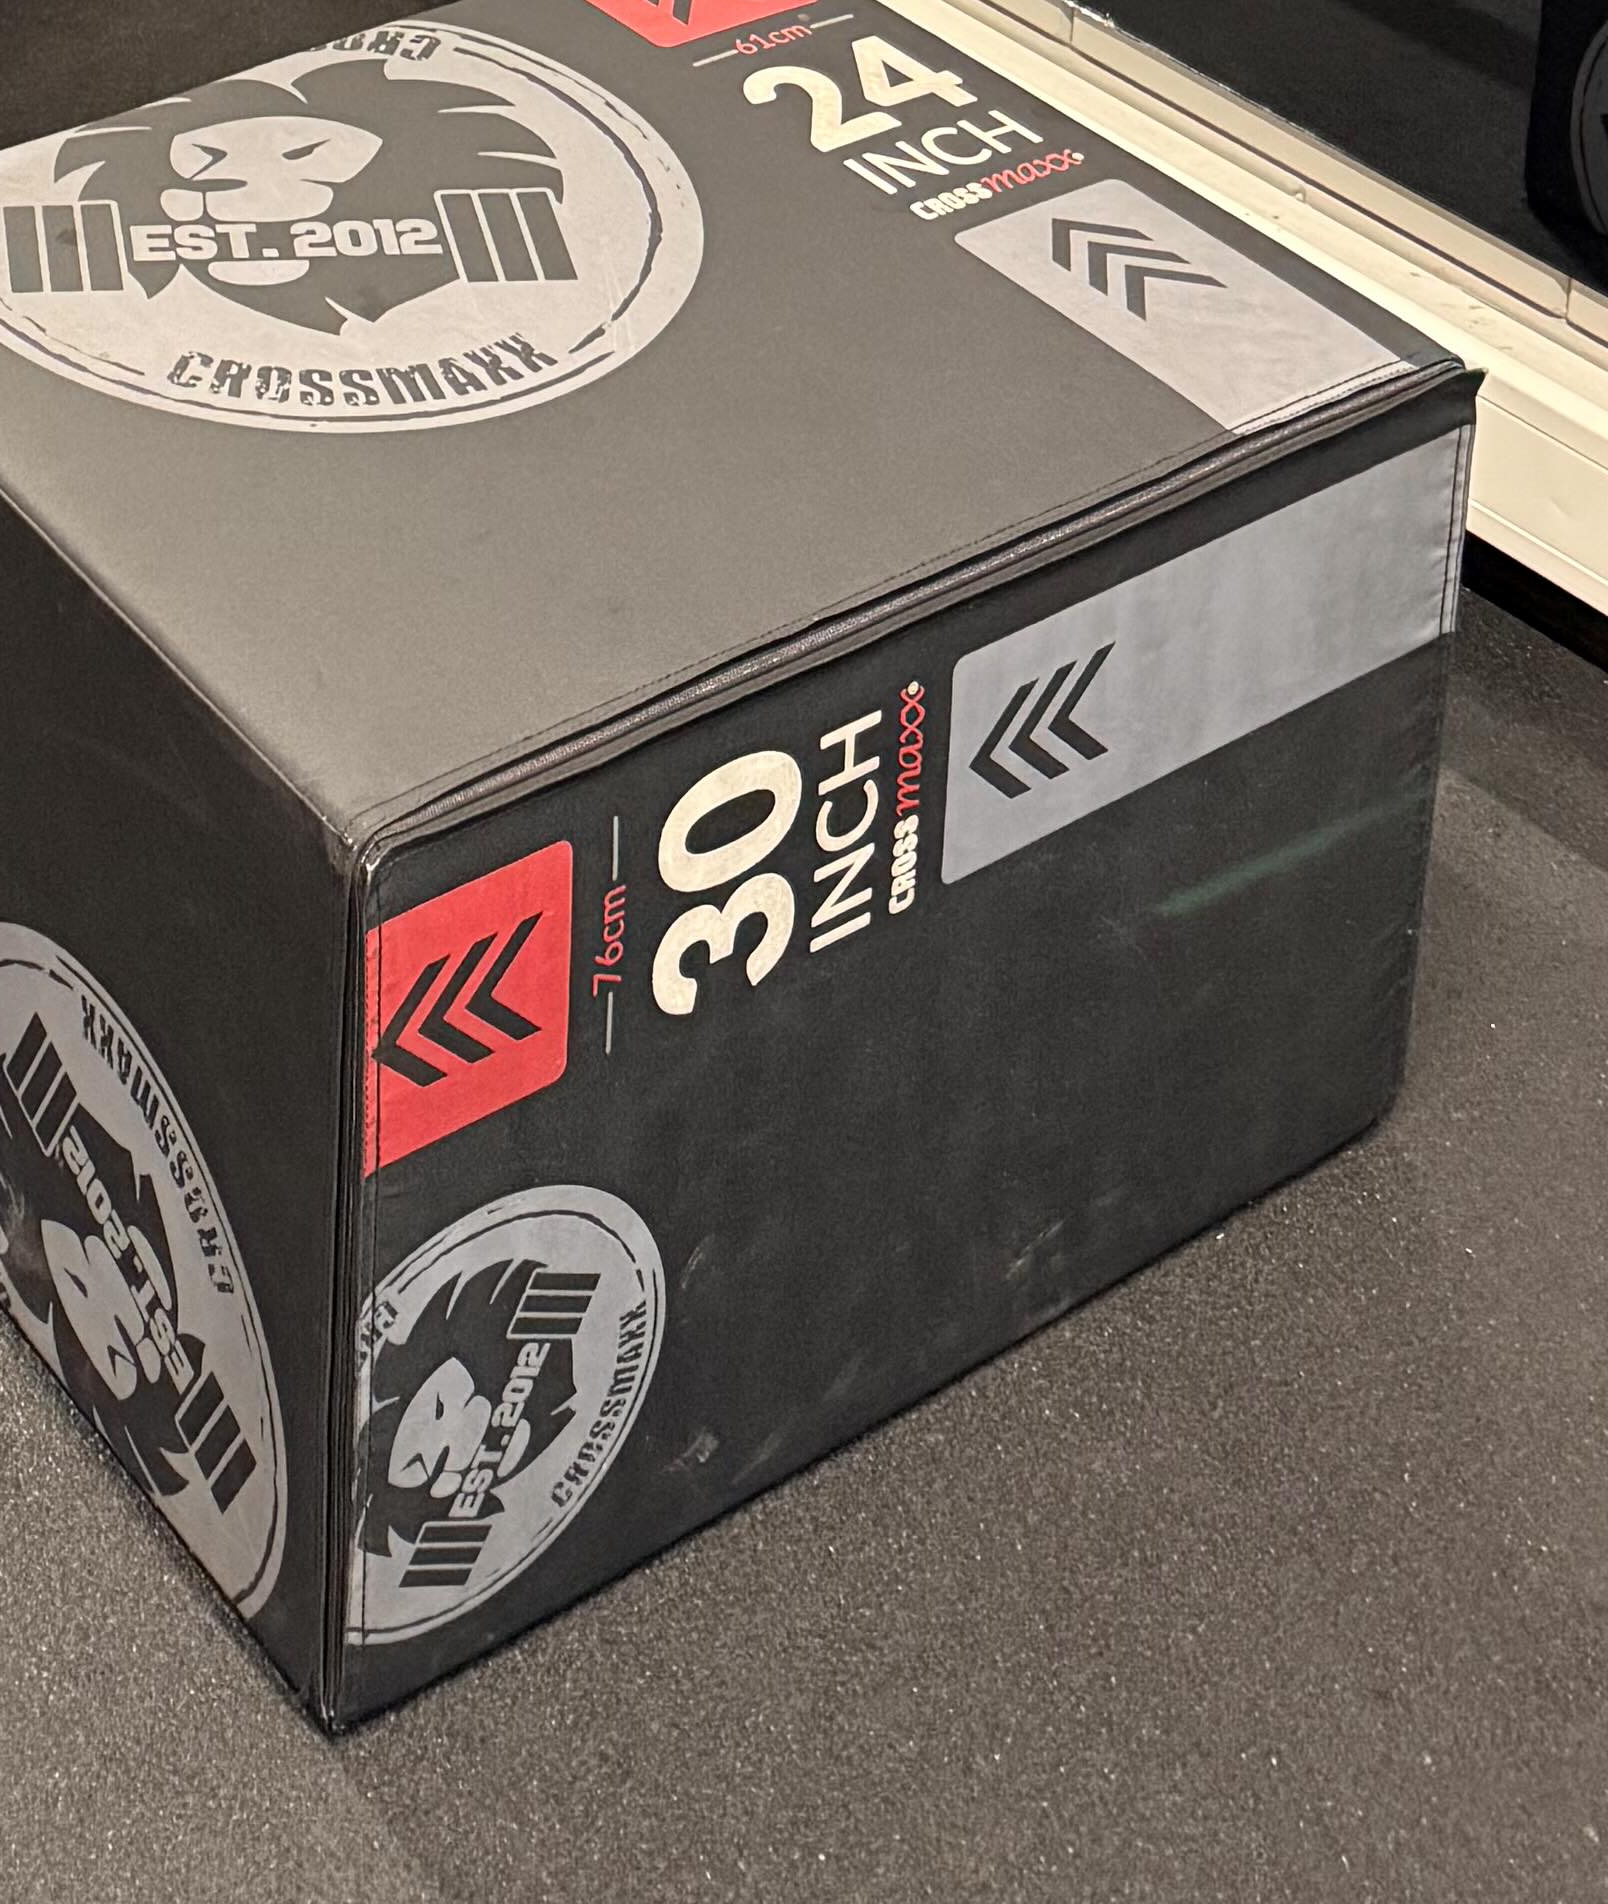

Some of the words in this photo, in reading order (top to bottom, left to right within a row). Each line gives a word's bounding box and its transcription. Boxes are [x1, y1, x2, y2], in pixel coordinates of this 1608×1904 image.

[735, 21, 813, 57] 61cm
[743, 34, 978, 154] 24
[842, 110, 1045, 196] INCH
[130, 221, 281, 263] EST.
[292, 218, 444, 259] 2012
[652, 750, 802, 1016] 30
[809, 709, 883, 953] INCH
[593, 884, 627, 997] 76cm
[61, 1125, 129, 1260] 2012
[491, 1341, 551, 1426] 2012
